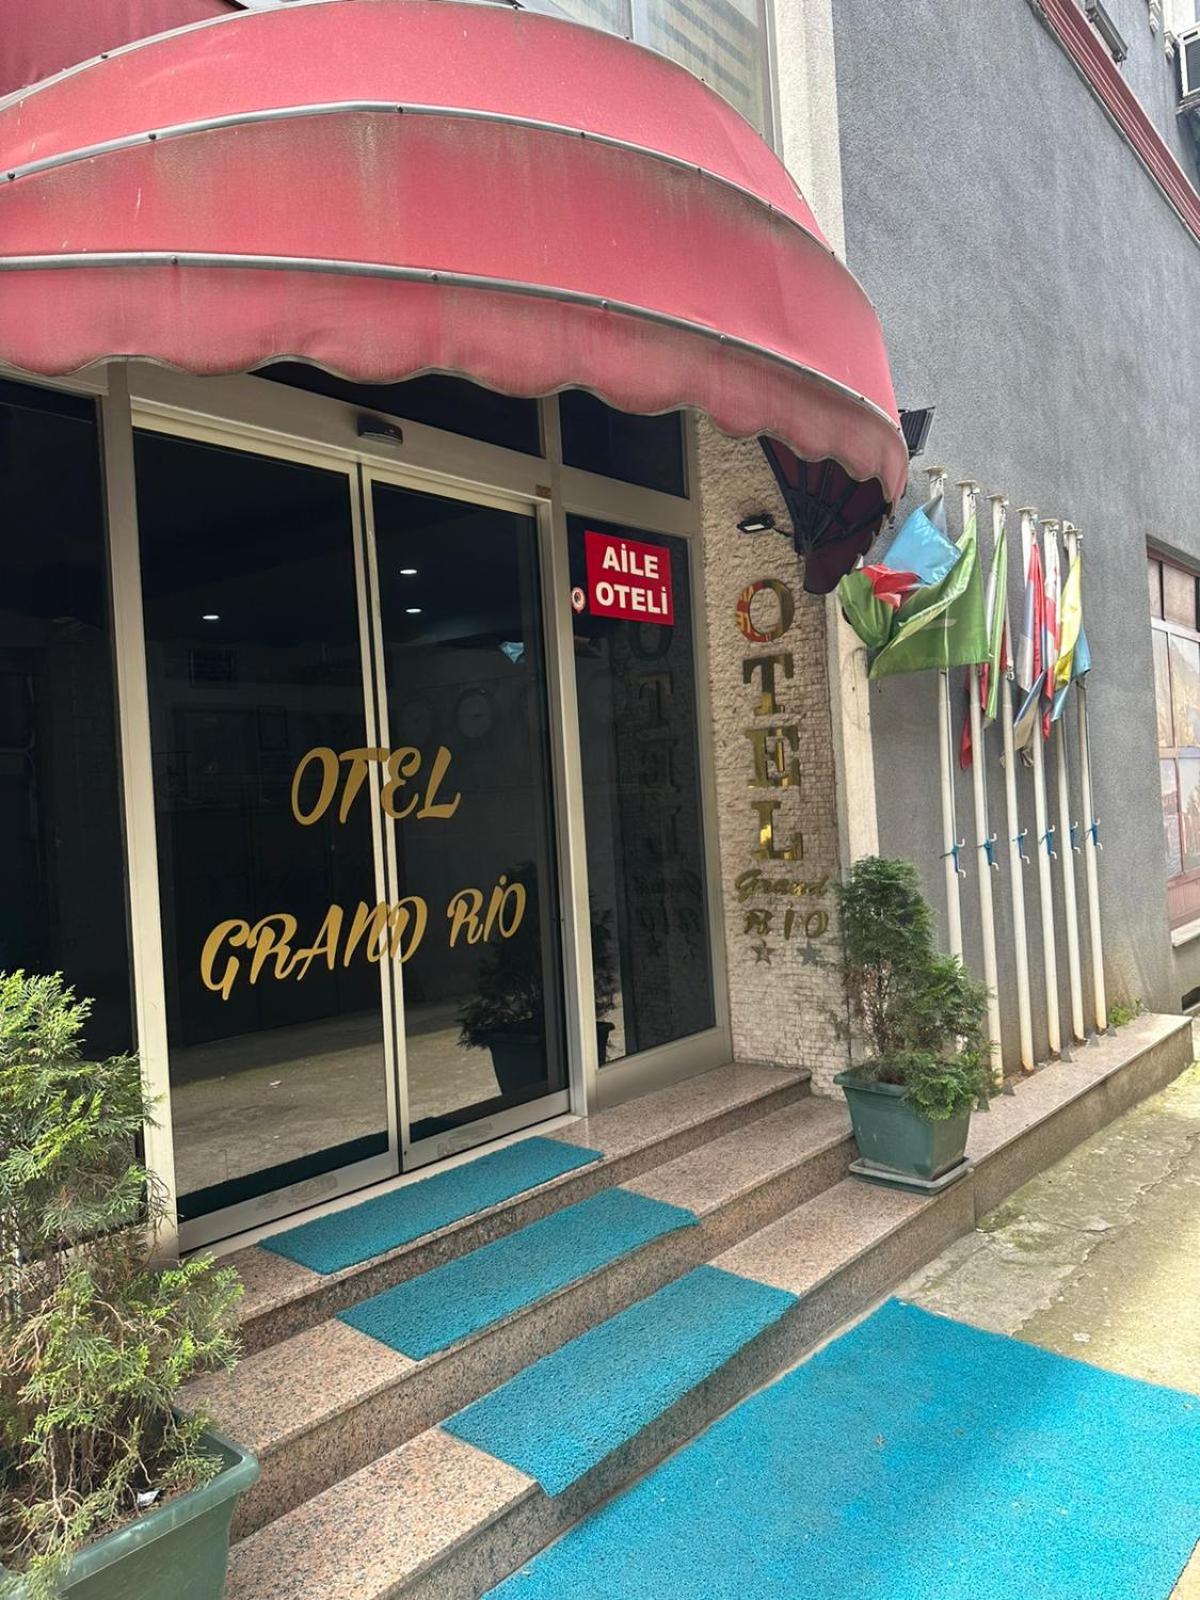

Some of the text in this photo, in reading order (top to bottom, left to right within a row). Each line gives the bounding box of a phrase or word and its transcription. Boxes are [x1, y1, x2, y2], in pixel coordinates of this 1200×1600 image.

[602, 543, 660, 580] AİLE
[595, 581, 668, 616] OTELİ
[736, 578, 804, 863] OTEL
[291, 746, 462, 826] OTEL
[735, 868, 829, 904] Grand
[200, 874, 527, 1001] GRAND RİO
